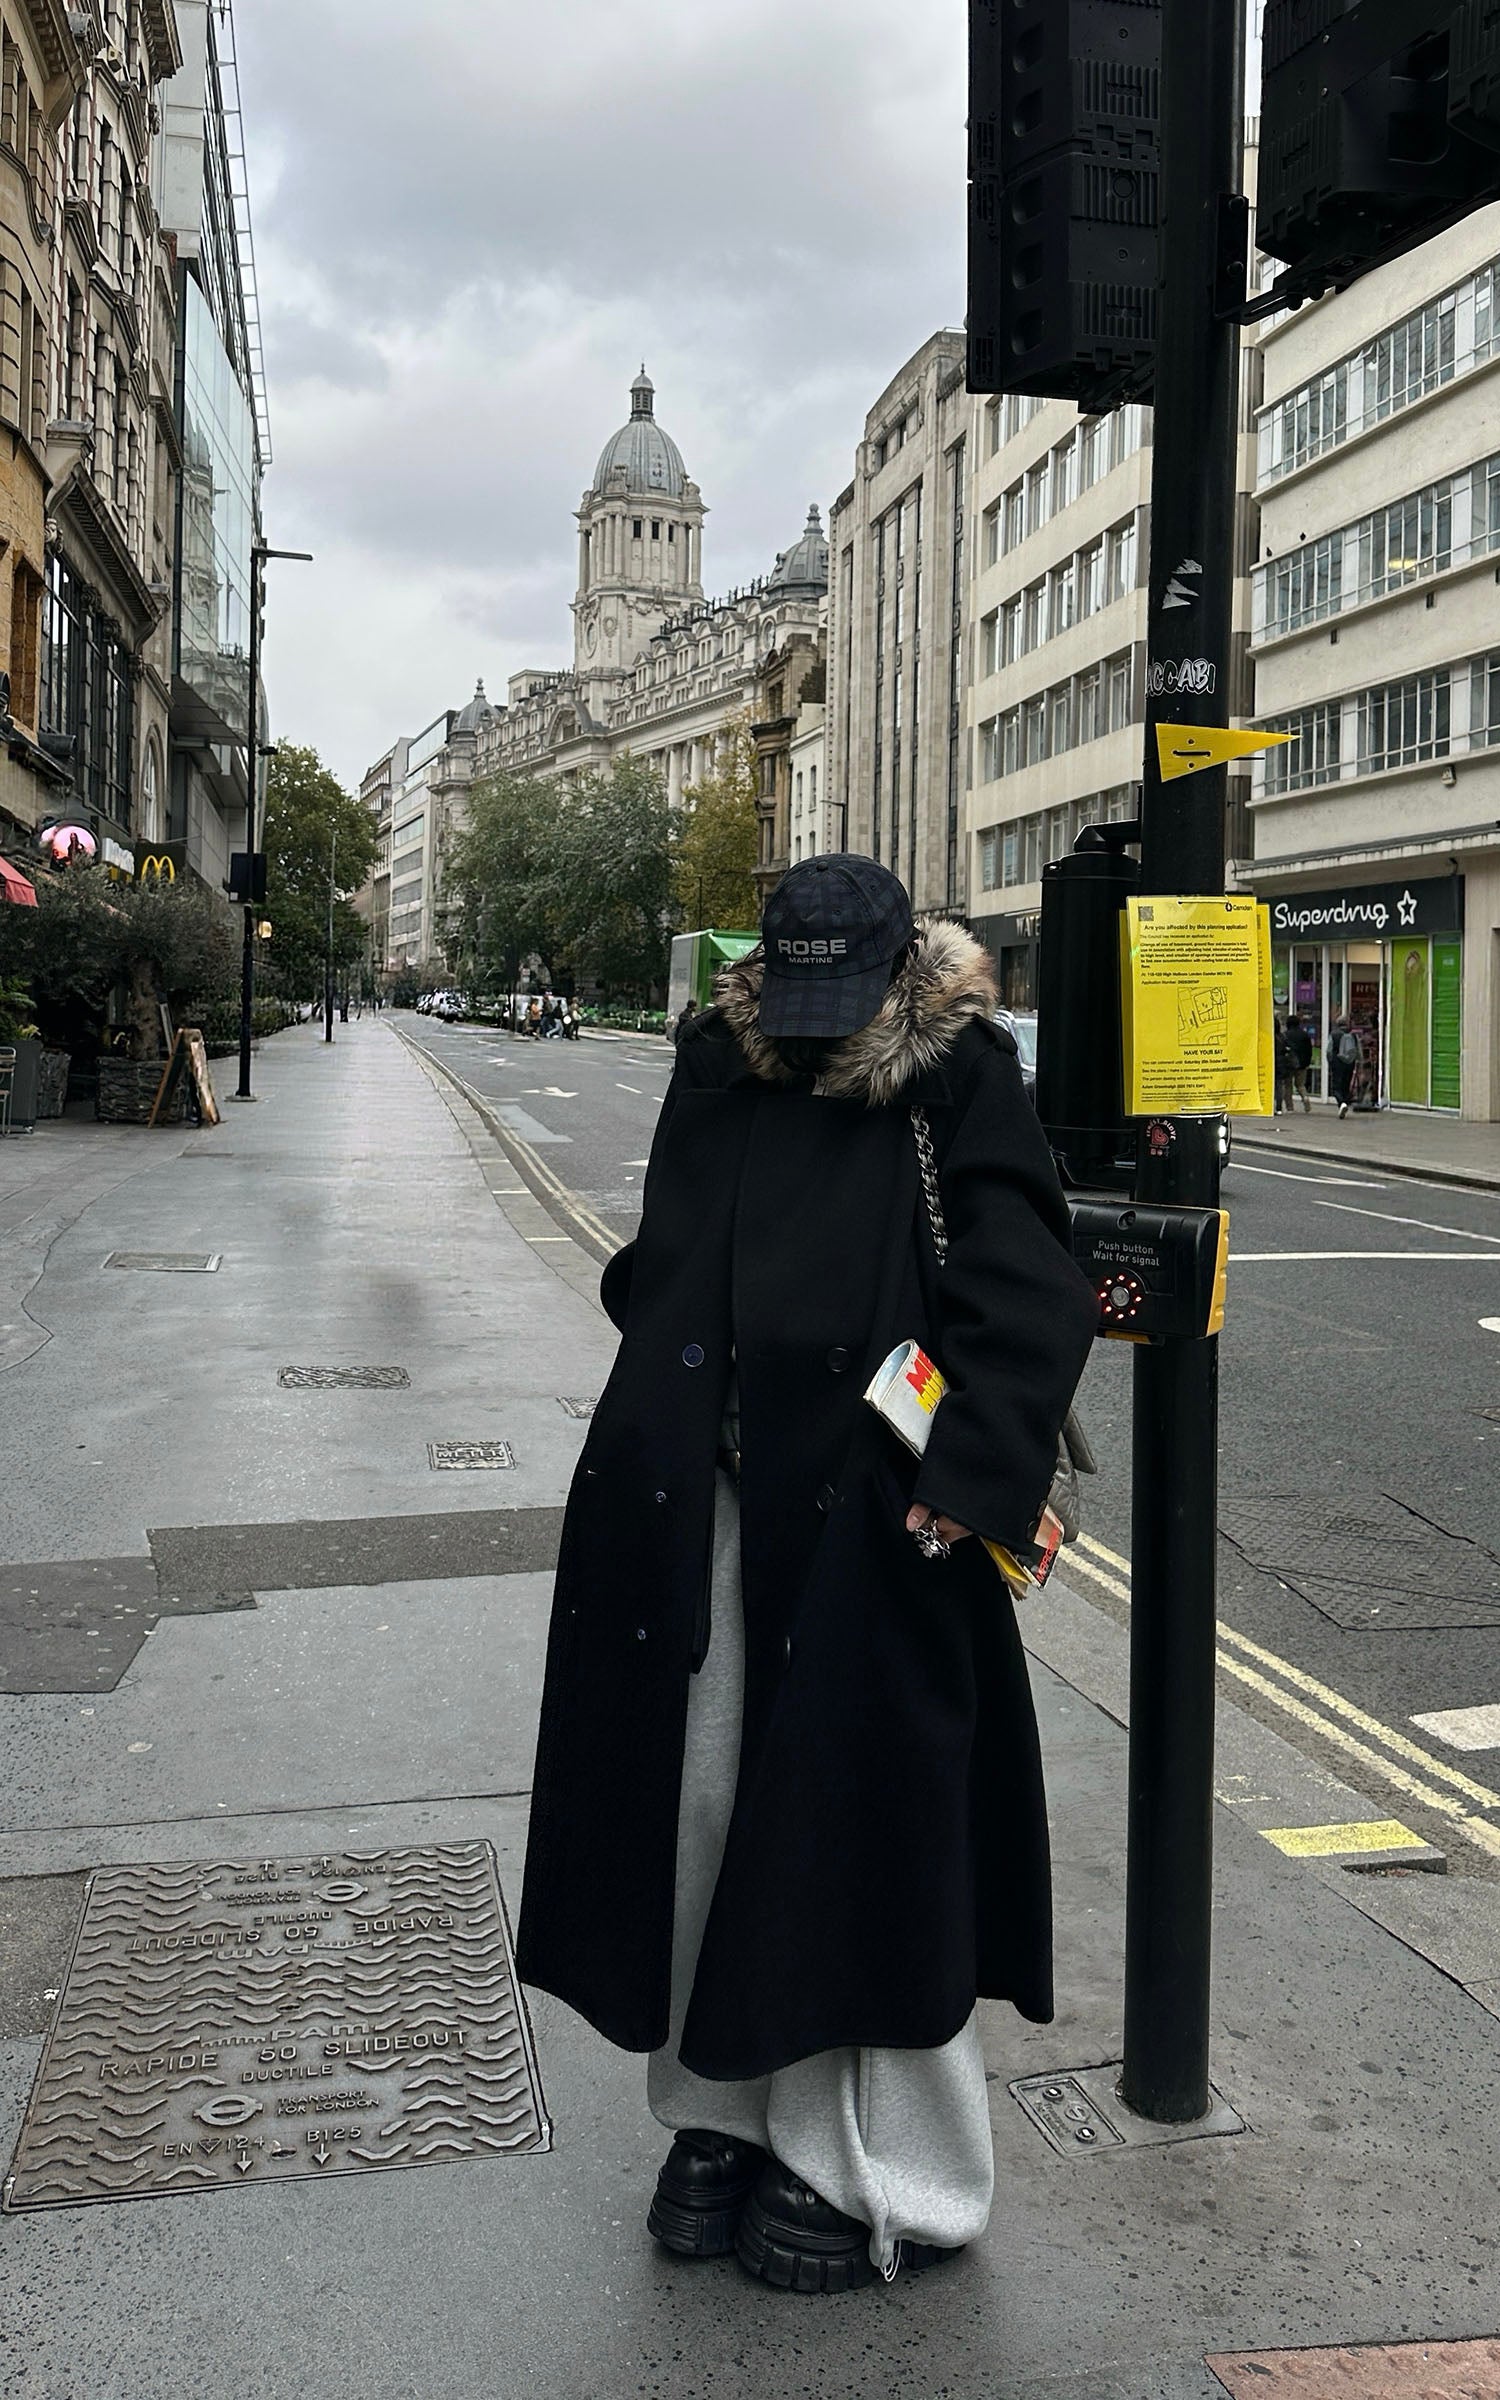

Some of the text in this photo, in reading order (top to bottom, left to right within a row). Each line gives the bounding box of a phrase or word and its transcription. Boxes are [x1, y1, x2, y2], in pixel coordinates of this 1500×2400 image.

[1274, 899, 1390, 933] Superdrug
[777, 938, 847, 956] ROSE
[788, 956, 833, 964] MARTINE
[1098, 1239, 1154, 1255] Push button
[1092, 1249, 1160, 1267] Wait for signal
[254, 1911, 333, 1926] DUCTILE
[130, 1914, 455, 1950] RAPIDE 50 SLIDEOUT
[99, 2029, 470, 2079] RAPIDE 50 SLIDEOUT
[241, 2063, 334, 2084] DUCTILE
[277, 2089, 367, 2105] TRANSPORT
[277, 2098, 380, 2116] FOR LONDON
[306, 2125, 363, 2143] B125
[162, 2135, 266, 2158] EN 124
